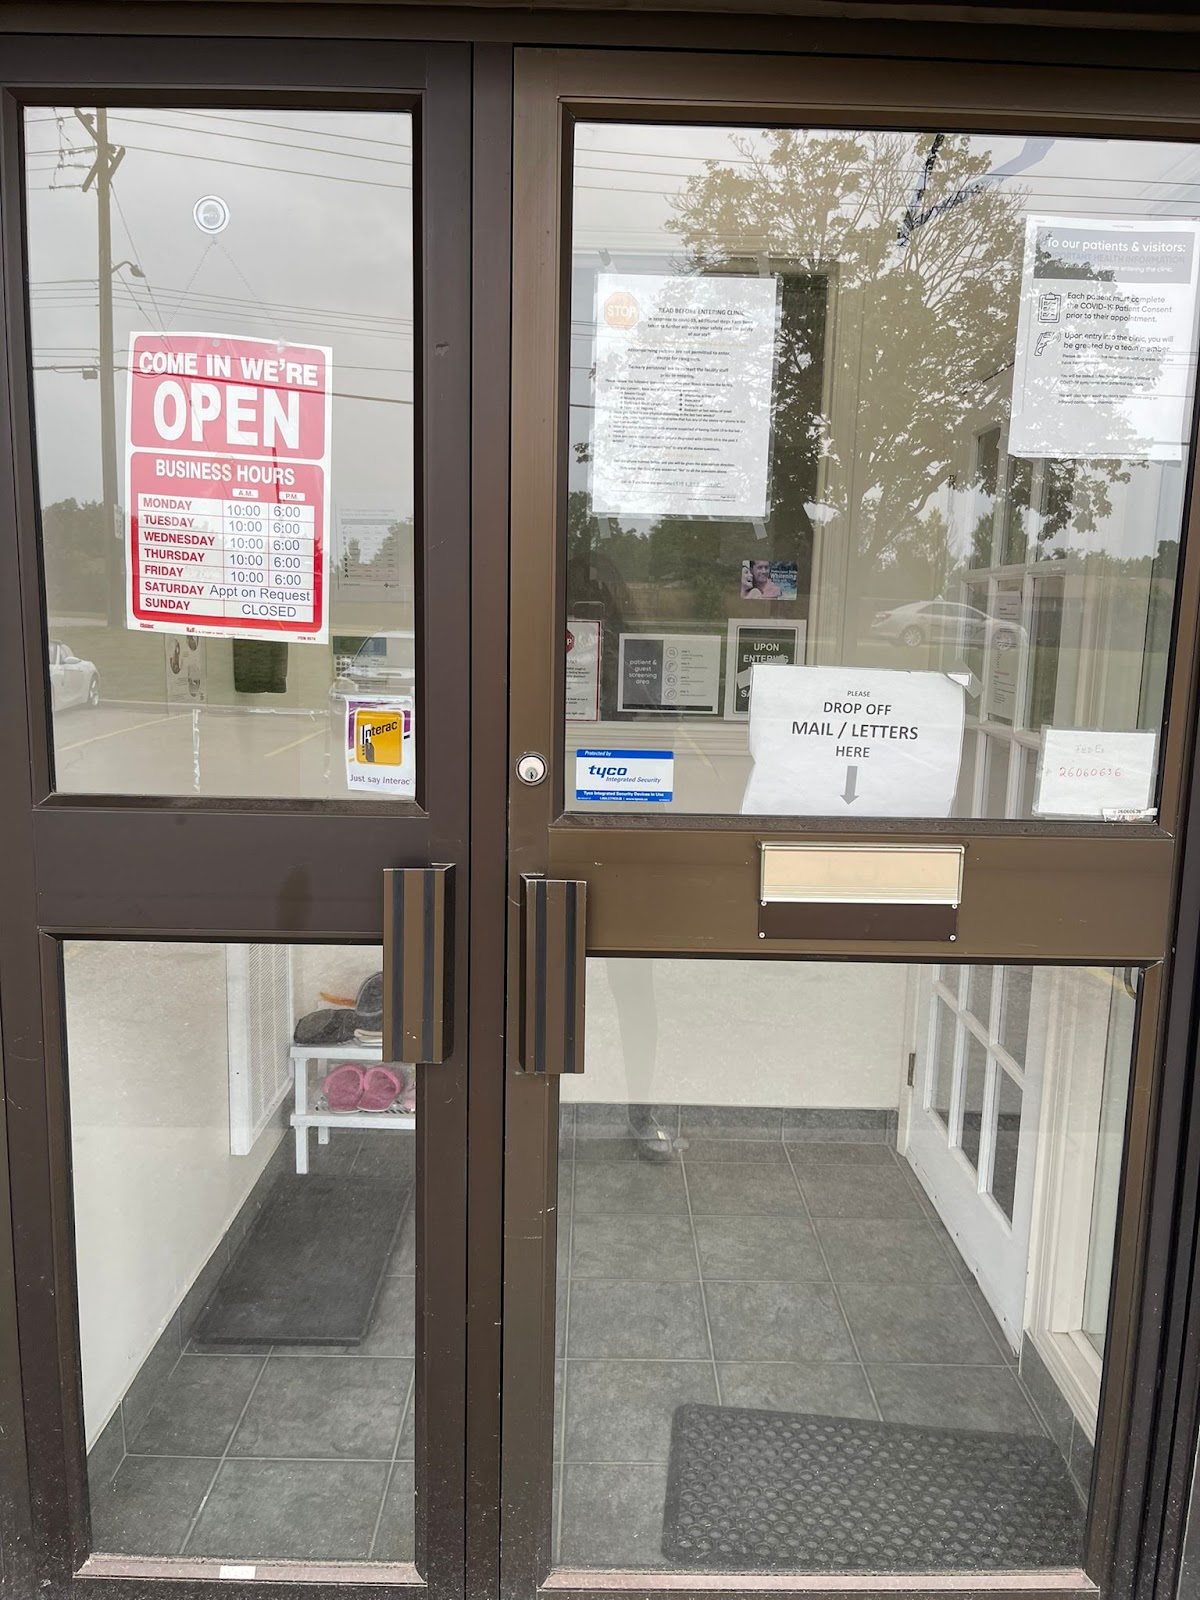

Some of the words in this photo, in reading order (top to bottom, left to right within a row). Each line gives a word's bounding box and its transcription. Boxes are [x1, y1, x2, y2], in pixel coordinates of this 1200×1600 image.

[1047, 238, 1058, 248] To
[1062, 240, 1079, 248] our
[1082, 240, 1128, 252] patients
[1131, 242, 1140, 252] &
[1142, 243, 1186, 253] visitors:
[1067, 292, 1085, 300] Each
[1131, 296, 1166, 305] complete
[607, 305, 637, 318] STOP
[1115, 305, 1140, 313] Patient
[1141, 306, 1173, 314] Consent
[1065, 313, 1083, 321] prior
[1093, 313, 1109, 321] their
[1064, 341, 1074, 349] be
[1104, 343, 1114, 352] by
[139, 351, 198, 376] COME
[207, 354, 231, 378] IN
[240, 356, 319, 387] WE'RE
[153, 379, 300, 450] OPEN
[156, 458, 232, 482] BUSINESS
[237, 464, 296, 486] HOURS
[237, 489, 255, 497] A.M.
[143, 497, 193, 511] MONDAY
[227, 505, 261, 517] 10:00
[273, 506, 301, 518] 6:00
[144, 514, 194, 528] TUESDAY
[228, 521, 262, 533] 10:00
[273, 522, 300, 535] 6:00
[144, 531, 215, 547] WEDNESDAY
[230, 538, 263, 550] 10:00
[273, 539, 300, 551] 6:00
[144, 548, 205, 563] THURSDAY
[229, 554, 263, 566] 10:00
[274, 556, 301, 568] 6:00
[145, 564, 184, 578] FRIDAY
[230, 571, 264, 583] 10:00
[274, 574, 302, 586] 6:00
[145, 581, 205, 596] SATURDAY
[209, 584, 237, 600] Appt
[241, 588, 257, 598] on
[259, 588, 311, 604] Request
[145, 598, 190, 611] SUNDAY
[241, 604, 297, 619] CLOSED
[754, 643, 779, 652] UPON
[743, 653, 789, 664] ENTERG
[628, 672, 657, 680] screening
[847, 690, 871, 698] PLEASE
[823, 702, 862, 715] DROP
[866, 703, 892, 716] OFF
[362, 721, 398, 745] Interac
[791, 721, 834, 737] MAIL
[837, 722, 848, 739] /
[851, 724, 919, 740] LETTERS
[835, 746, 870, 758] HERE
[588, 765, 628, 778] tyco
[350, 774, 365, 782] Just
[367, 776, 381, 784] say
